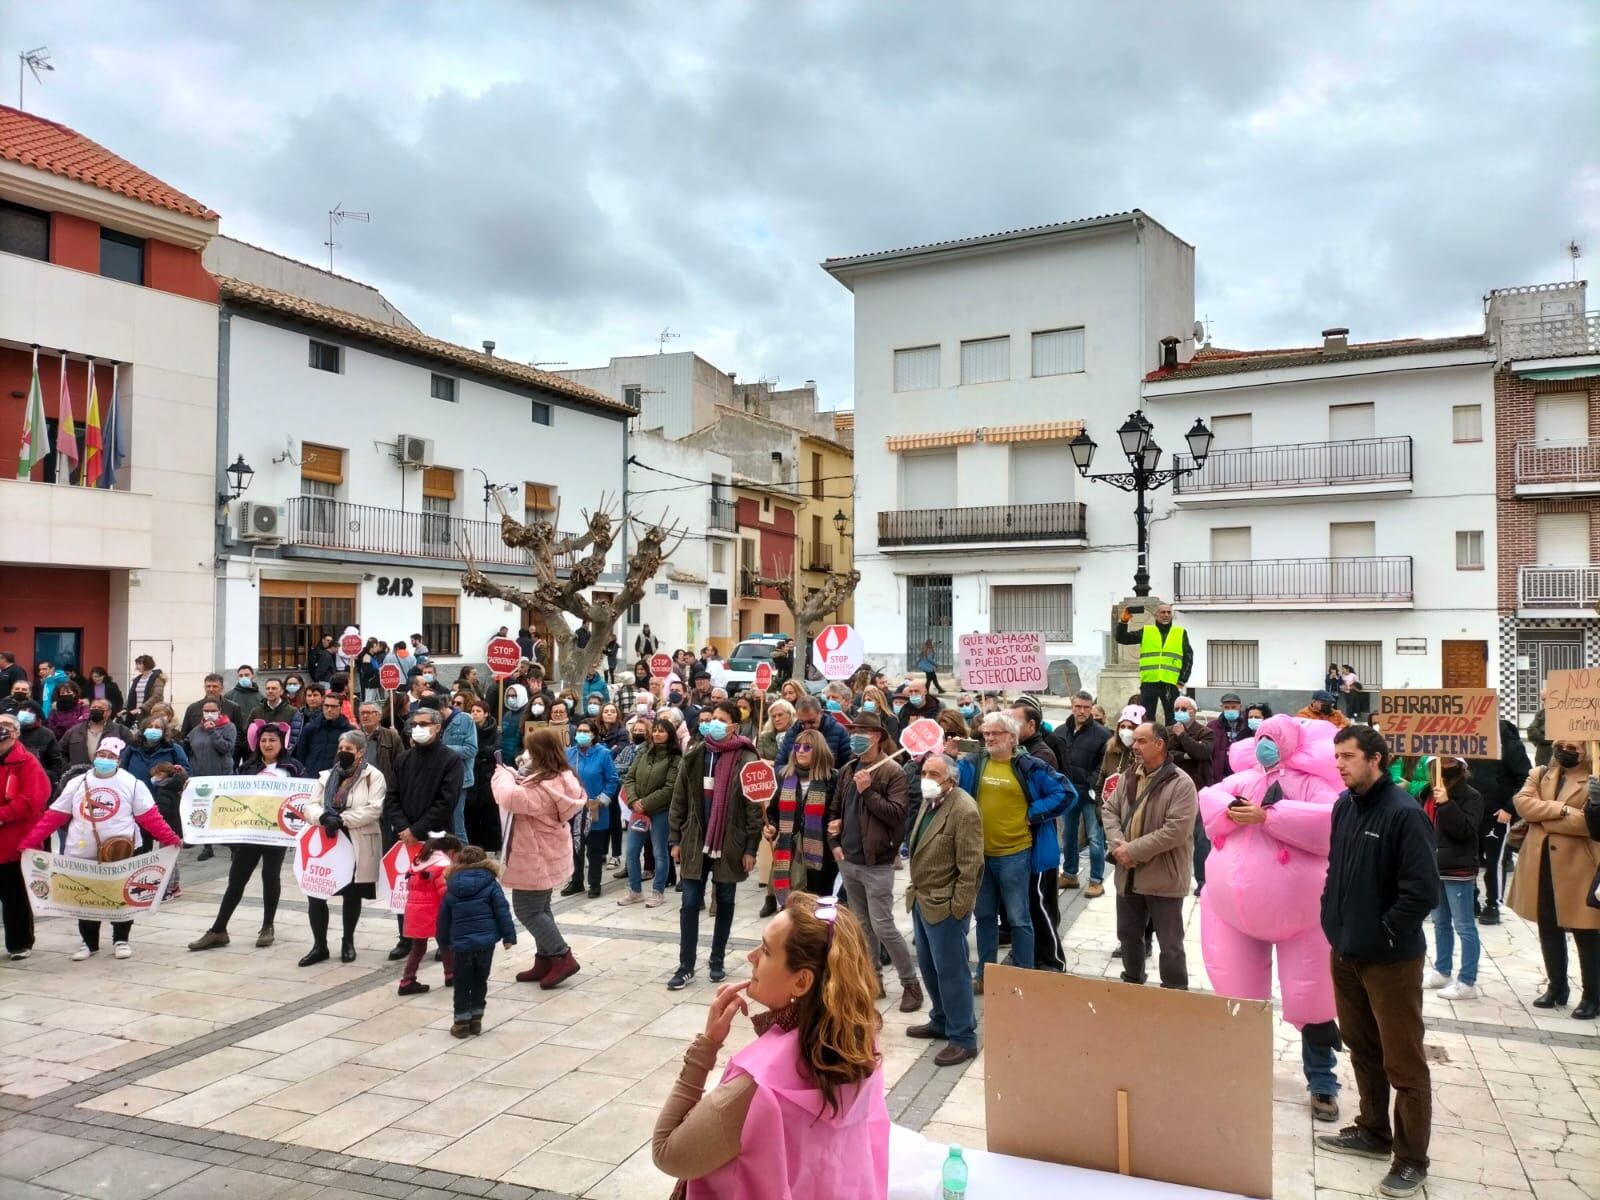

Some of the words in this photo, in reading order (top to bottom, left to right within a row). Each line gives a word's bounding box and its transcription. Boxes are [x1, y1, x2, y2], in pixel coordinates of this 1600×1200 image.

[376, 576, 414, 598] BAR
[963, 635, 983, 646] QUE
[985, 634, 999, 644] NO
[1002, 633, 1039, 643] HAGAN
[493, 646, 515, 655] STOP
[970, 648, 983, 656] DE
[988, 644, 1033, 656] NUESTROS
[830, 656, 848, 664] STOP
[975, 655, 1018, 667] PUEBLOS
[1021, 655, 1036, 663] UN
[969, 666, 1042, 684] ESTERCOLERO
[1568, 669, 1590, 689] NO
[1381, 695, 1464, 714] BARAJAS
[1465, 695, 1495, 716] NO
[1383, 715, 1412, 732] SE
[1414, 716, 1482, 735] VENDE
[1385, 733, 1406, 754] SE
[1411, 734, 1488, 756] DEFIENDE
[746, 770, 768, 782] STOP
[217, 781, 251, 790] SALVEMOS
[253, 781, 288, 791] NUESTROS
[289, 781, 313, 792] PUEBL
[53, 858, 88, 873] SALVEMOS
[89, 864, 127, 876] NUESTROS
[127, 854, 160, 871] PUEBLOS
[310, 864, 331, 877] STOP
[399, 882, 408, 892] ST
